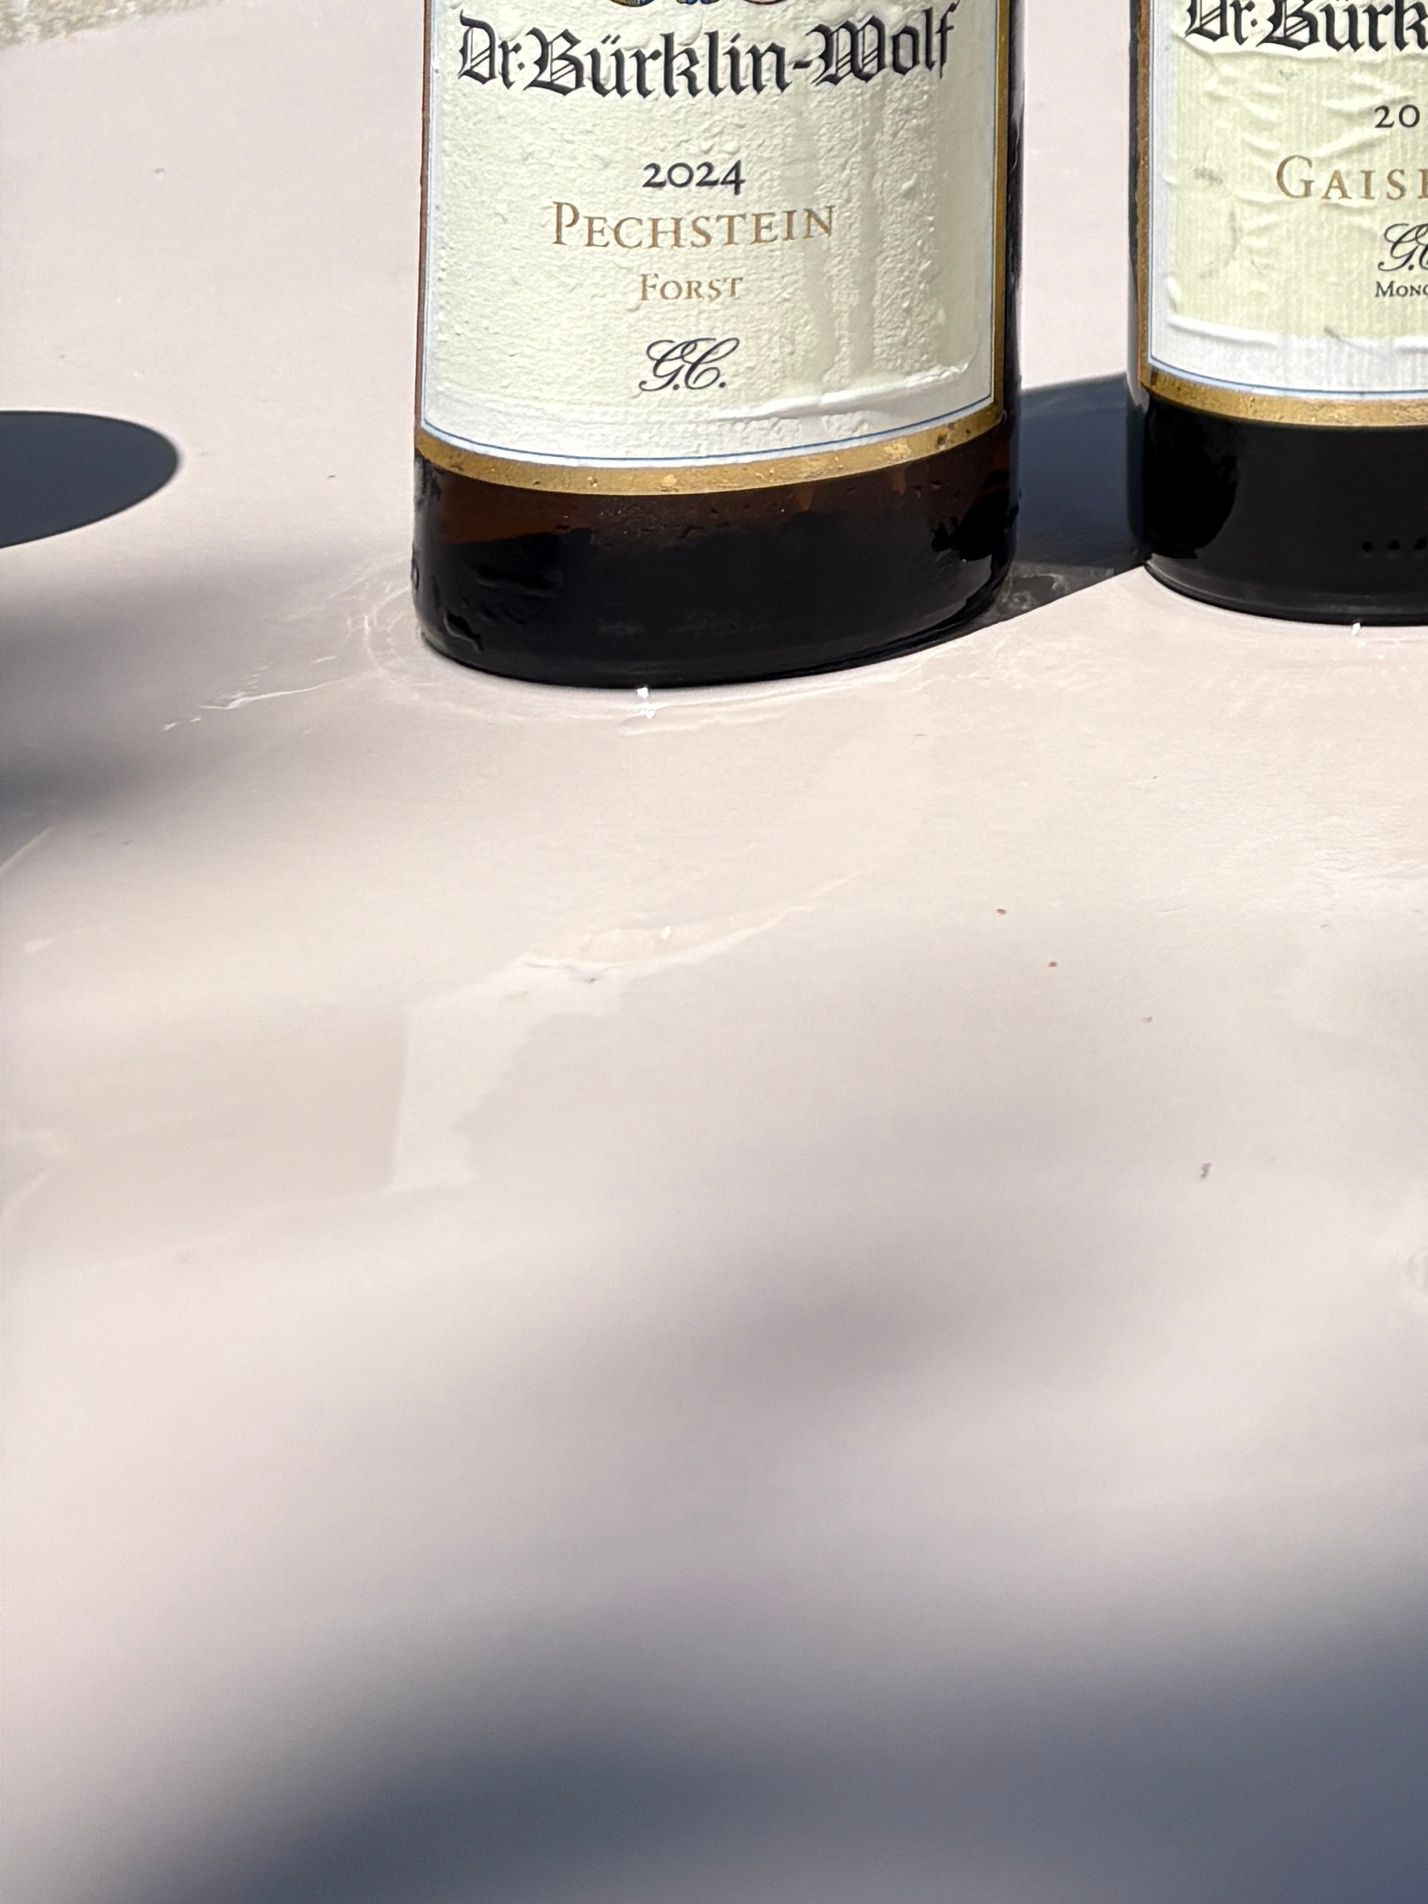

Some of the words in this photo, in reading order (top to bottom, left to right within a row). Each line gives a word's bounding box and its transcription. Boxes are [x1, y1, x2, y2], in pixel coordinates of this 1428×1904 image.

[641, 159, 746, 196] 2024
[552, 200, 835, 250] PECHSTEIN
[640, 273, 745, 303] FORST
